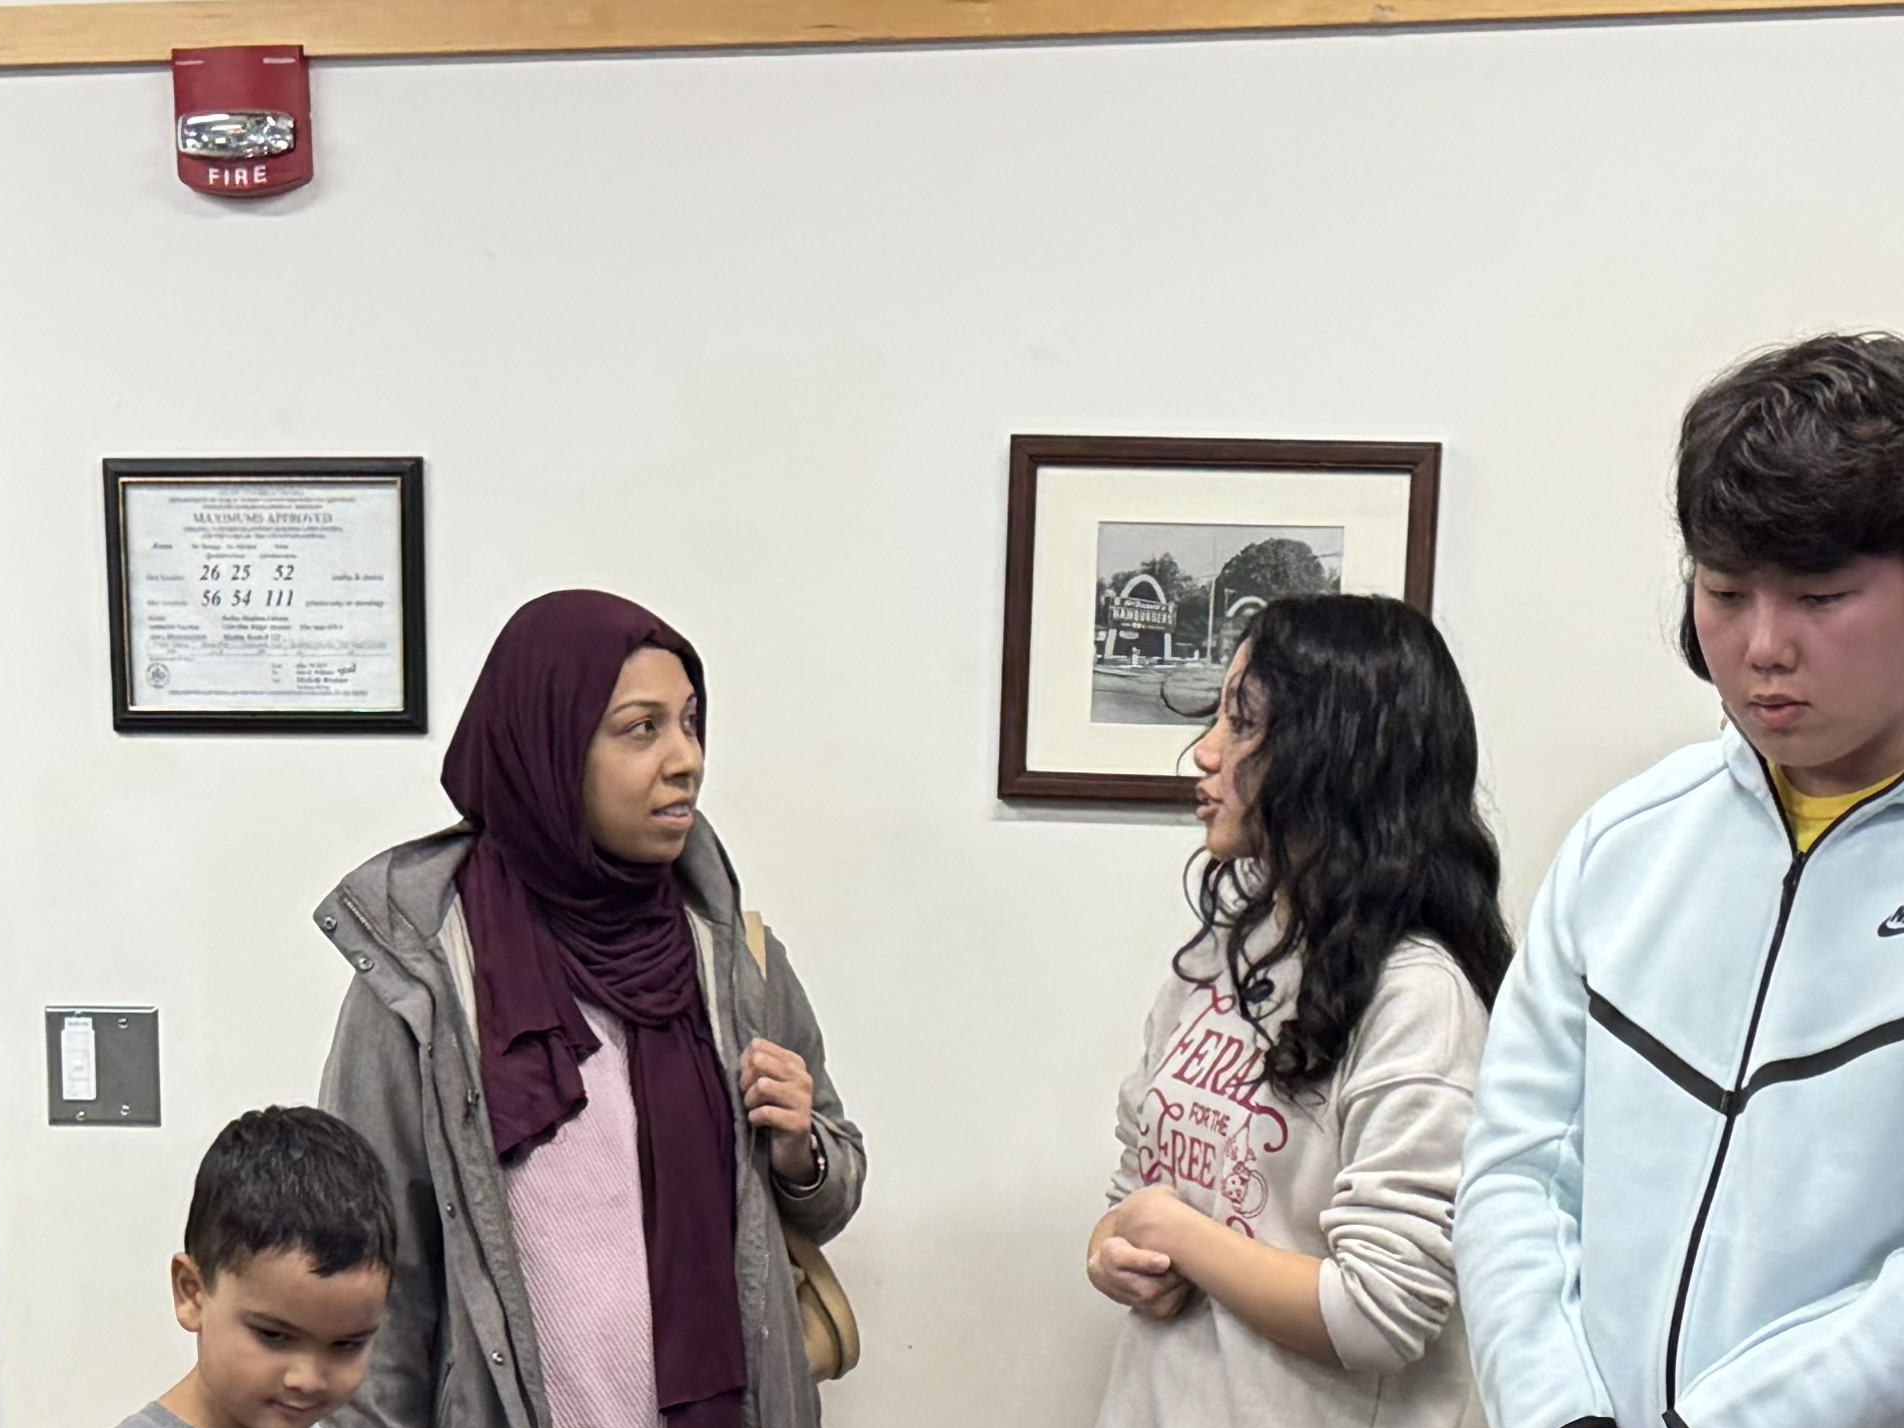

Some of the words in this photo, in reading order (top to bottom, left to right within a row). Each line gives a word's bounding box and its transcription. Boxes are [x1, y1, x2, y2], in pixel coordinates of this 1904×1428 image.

[208, 164, 268, 186] FIRE
[199, 564, 221, 581] 26
[230, 564, 251, 581] 25
[274, 564, 295, 581] 52
[201, 590, 222, 607] 56
[231, 589, 252, 607] 54
[266, 589, 293, 607] 111
[1188, 1101, 1211, 1129] FOR
[1209, 1109, 1231, 1137] THE
